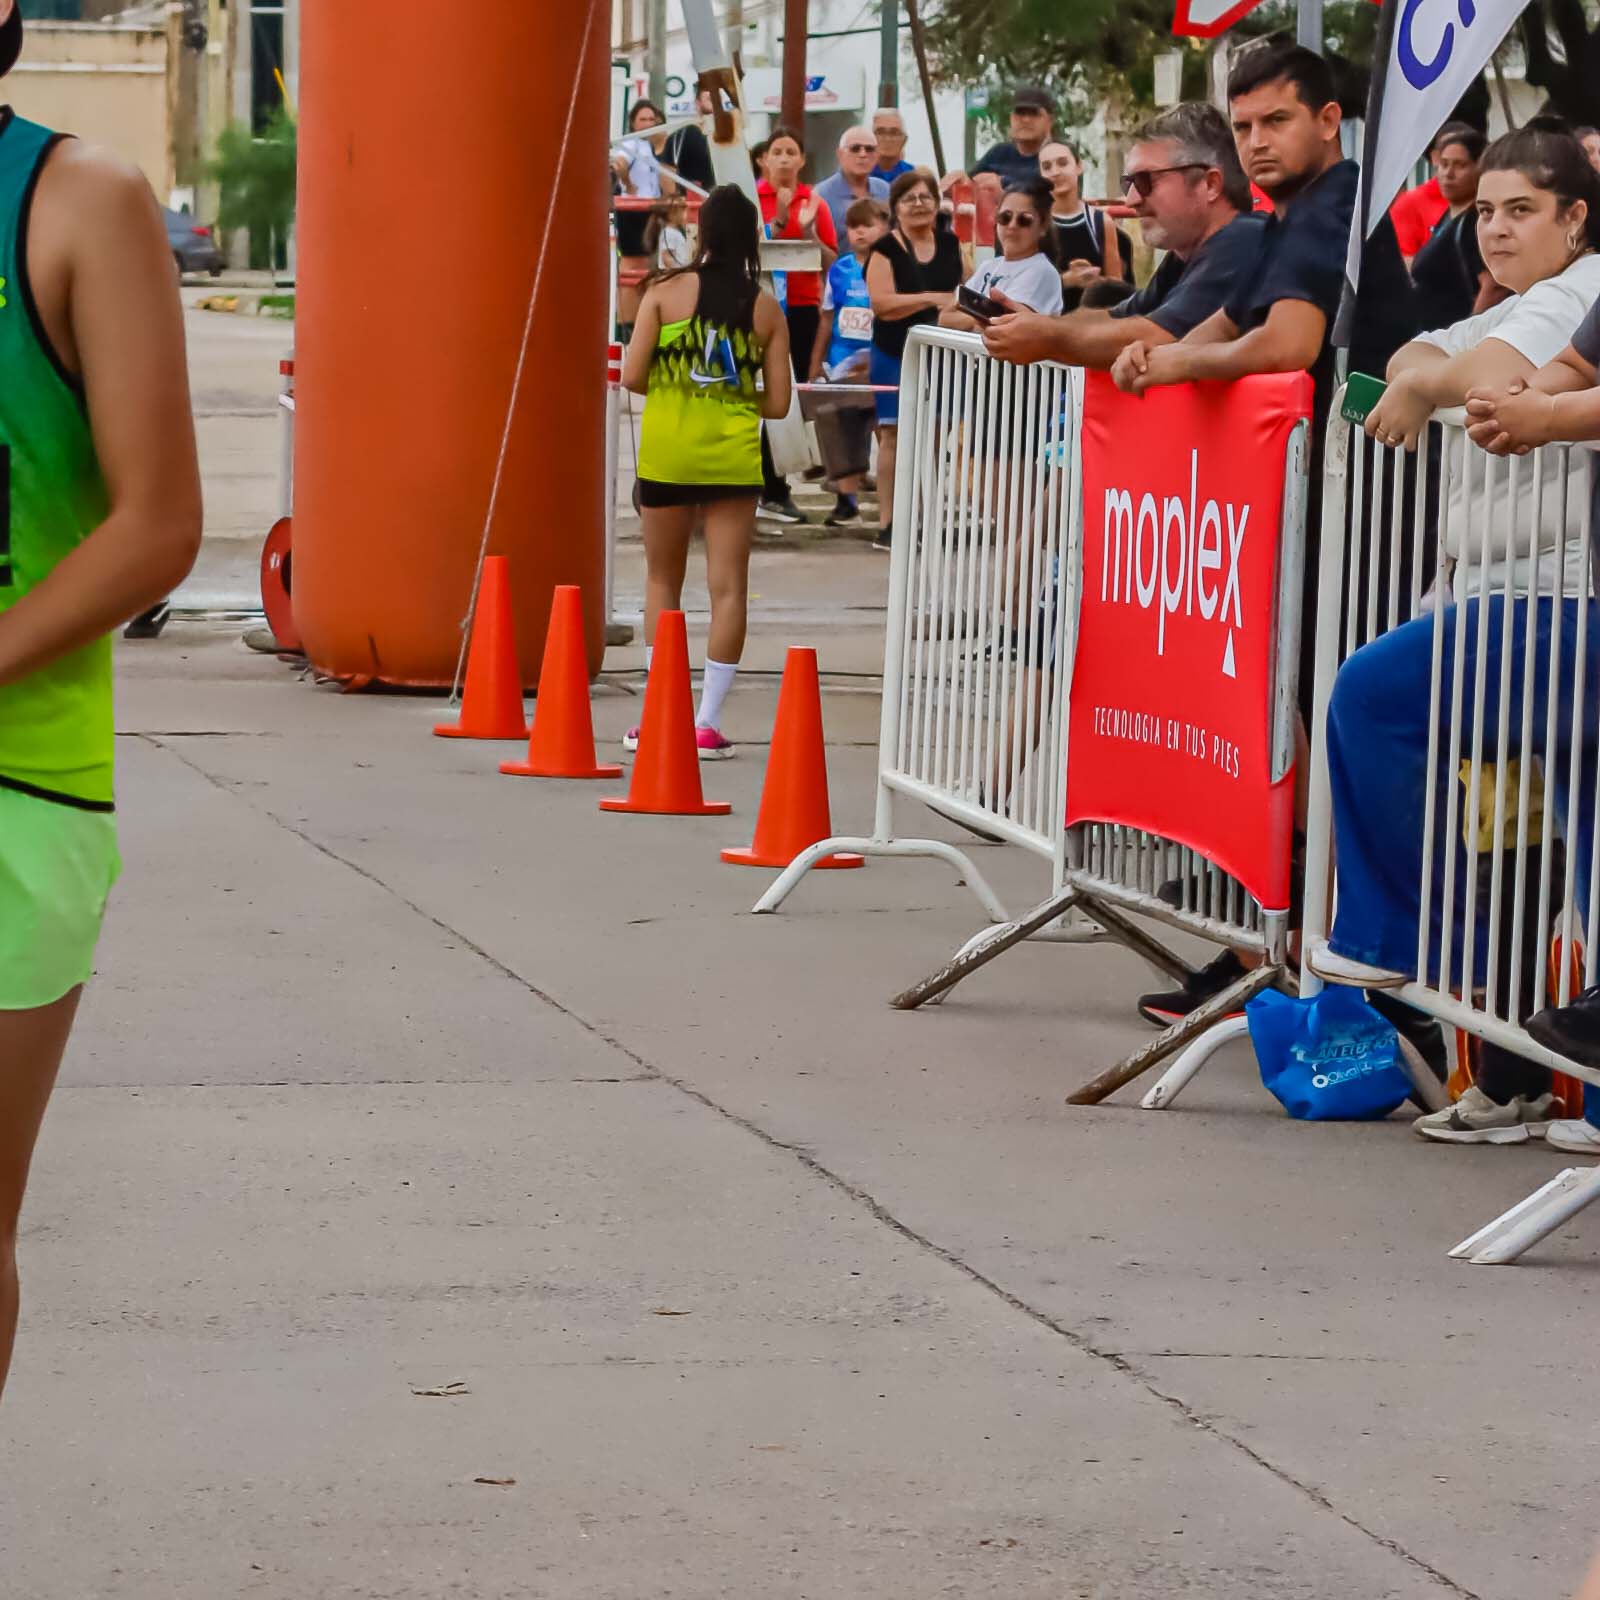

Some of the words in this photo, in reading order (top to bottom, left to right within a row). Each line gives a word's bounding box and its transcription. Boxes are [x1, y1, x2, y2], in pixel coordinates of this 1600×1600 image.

[1100, 448, 1251, 656] moplex
[1094, 707, 1161, 746] TECNOLOGIA
[1167, 719, 1180, 750] EN
[1185, 724, 1206, 760] TUS
[1213, 735, 1240, 779] PIES
